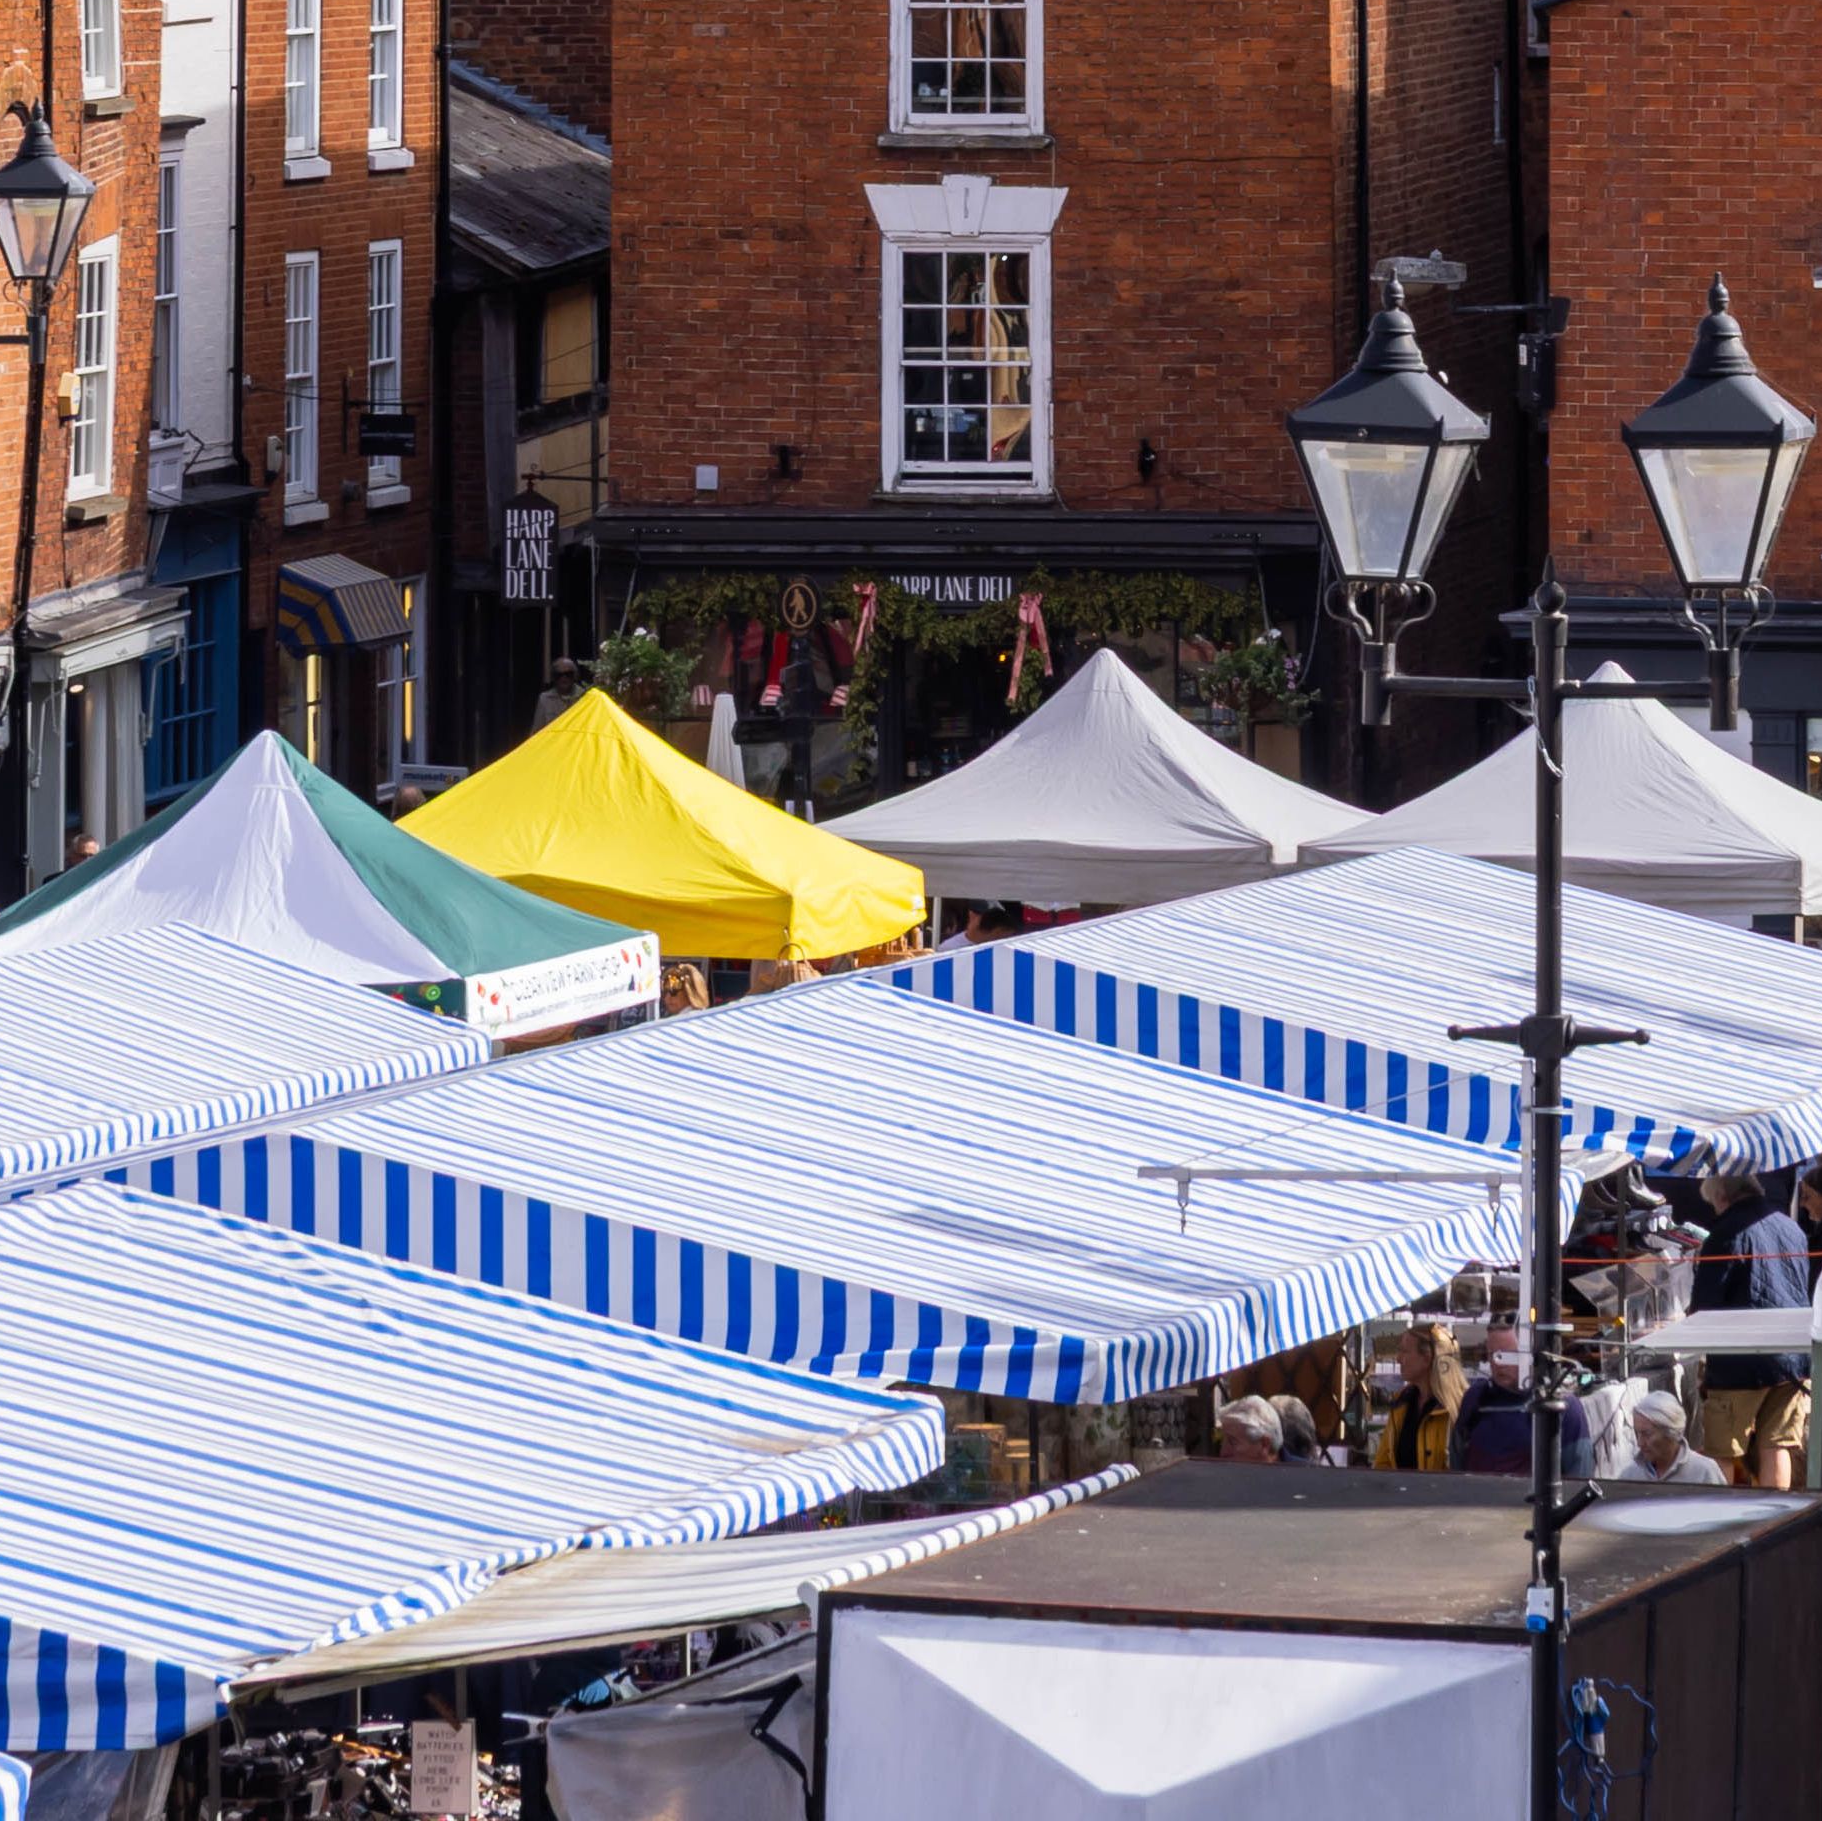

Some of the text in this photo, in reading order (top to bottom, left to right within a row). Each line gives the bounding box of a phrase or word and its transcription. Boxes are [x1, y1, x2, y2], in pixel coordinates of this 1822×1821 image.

[506, 509, 555, 539] HARP
[506, 539, 553, 569] LANE
[506, 569, 554, 599] DELI.
[890, 575, 931, 596] ARP
[935, 576, 975, 602] LANE
[417, 1742, 464, 1751] BATTERIES
